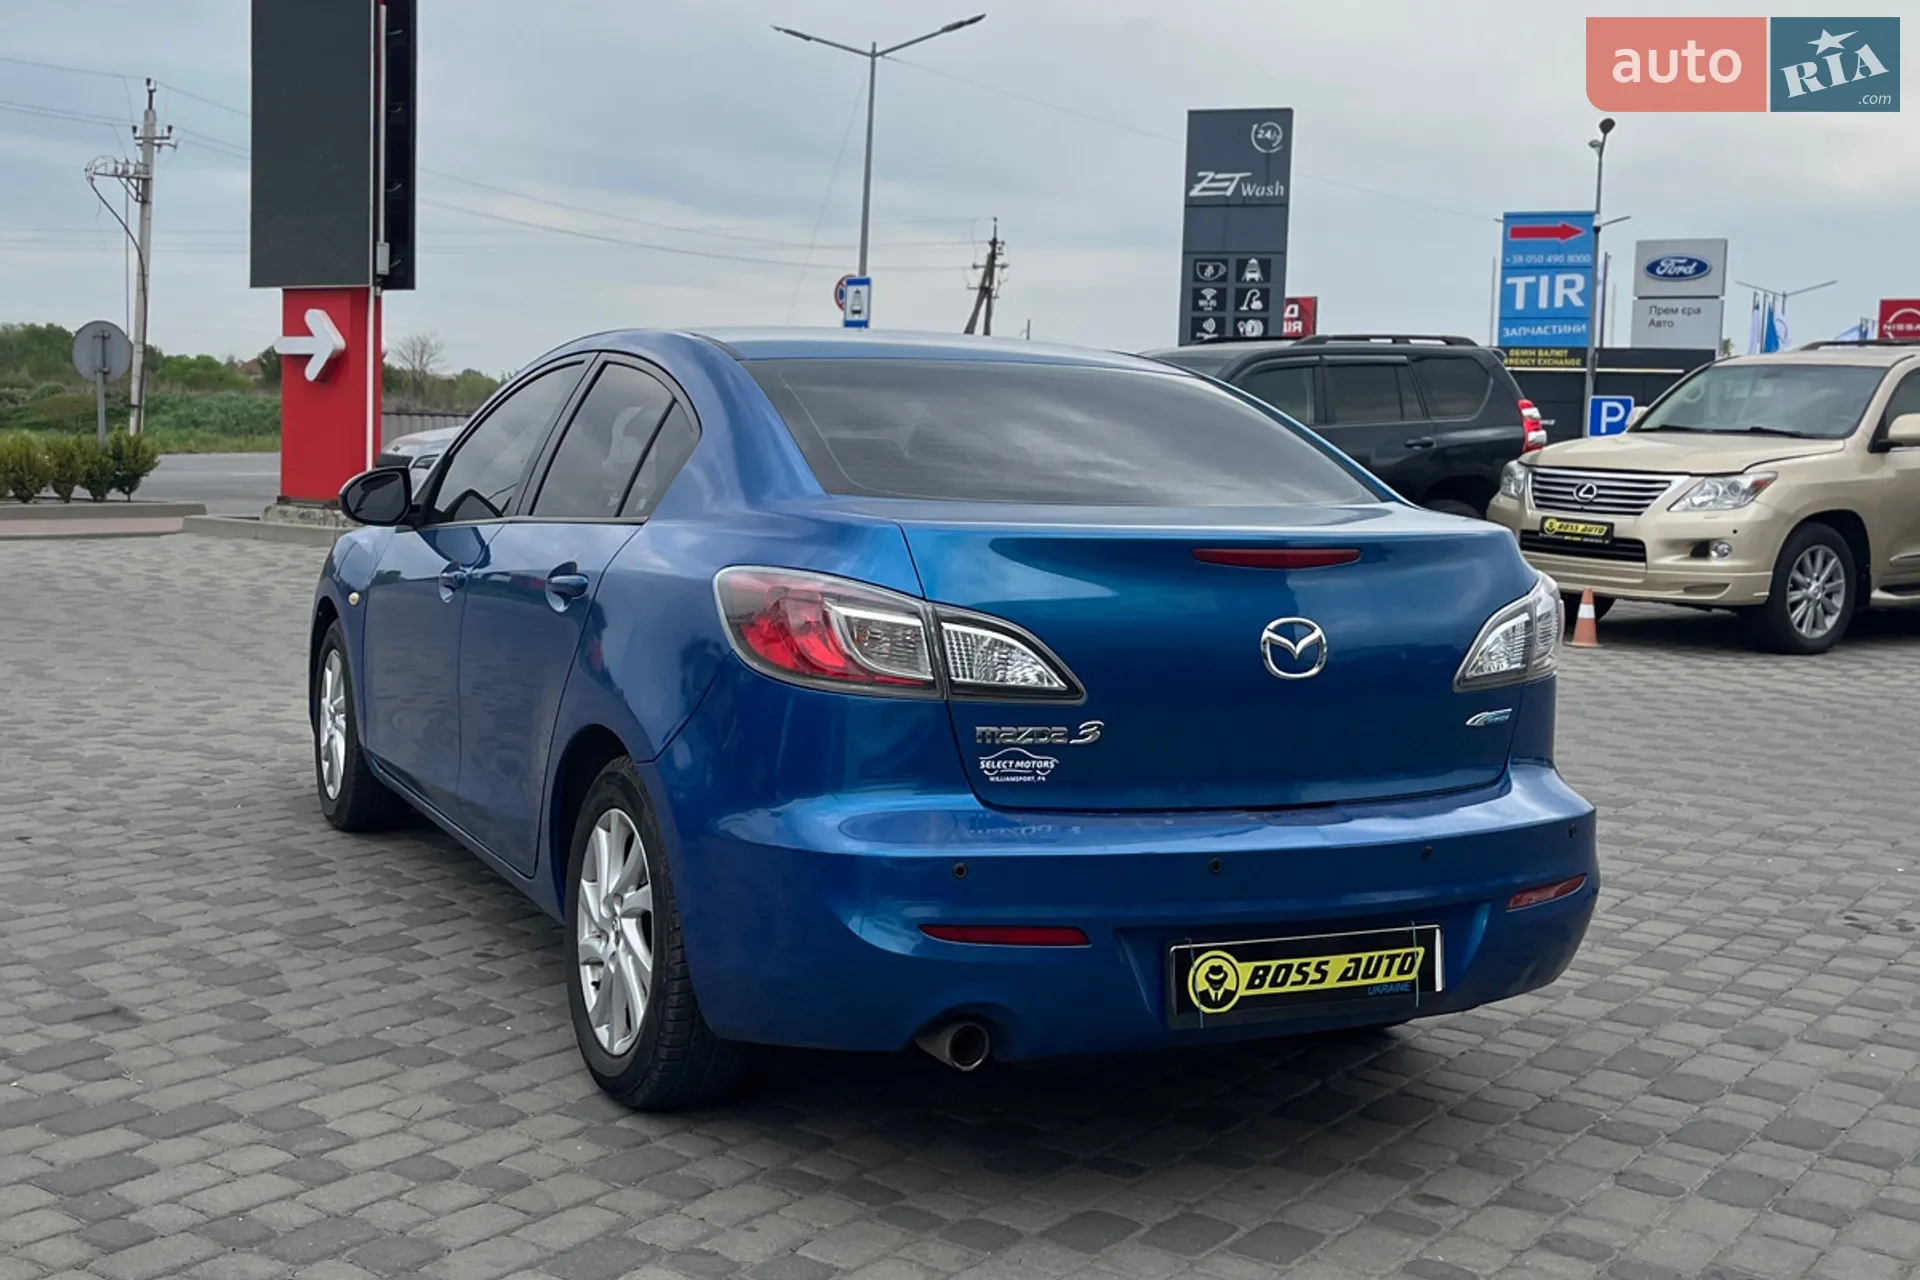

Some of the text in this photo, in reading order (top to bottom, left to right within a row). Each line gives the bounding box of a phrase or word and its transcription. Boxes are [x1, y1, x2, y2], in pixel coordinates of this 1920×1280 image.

[1189, 171, 1284, 197] ZET Wash
[1655, 258, 1698, 275] Ford
[1506, 273, 1586, 310] TIR
[1649, 305, 1679, 316] Прем
[1503, 324, 1587, 337] ЗАПЧАСТИНИ
[1648, 318, 1675, 328] Авто
[1883, 323, 1920, 331] NISSA
[1600, 401, 1625, 434] P
[975, 720, 1105, 745] mazda 3
[980, 760, 1055, 769] SELECT MOTORS
[1245, 951, 1420, 990] BOSS AUTO
[1367, 982, 1412, 996] UKRAINE
